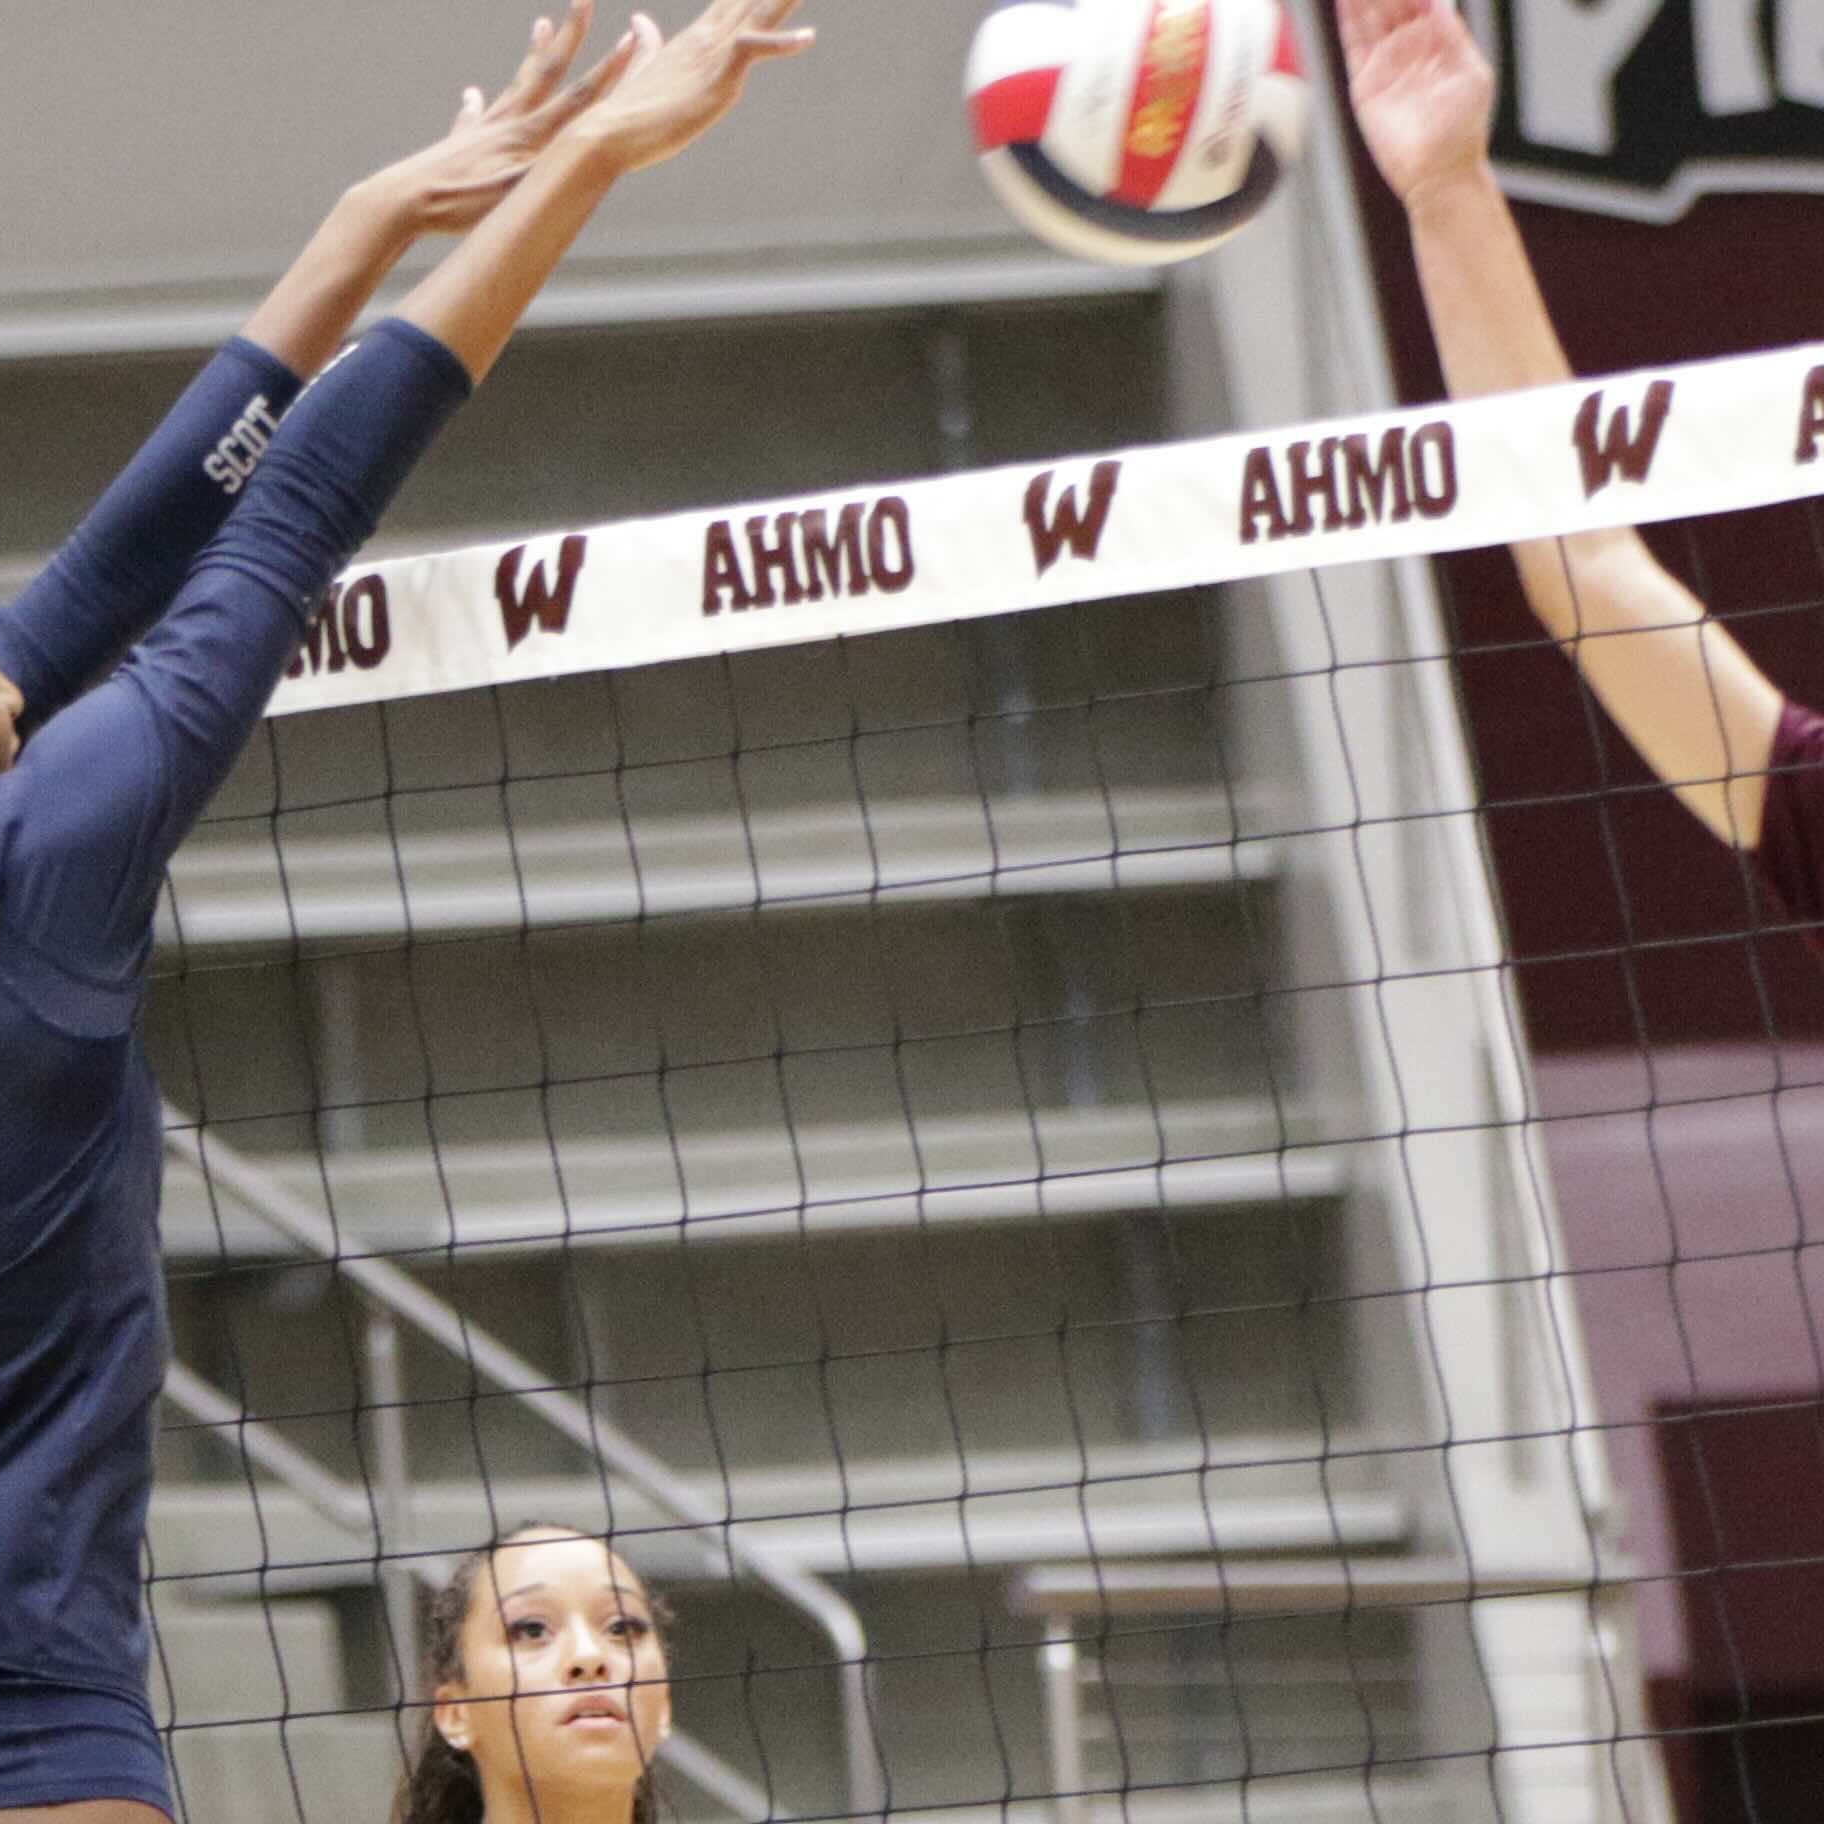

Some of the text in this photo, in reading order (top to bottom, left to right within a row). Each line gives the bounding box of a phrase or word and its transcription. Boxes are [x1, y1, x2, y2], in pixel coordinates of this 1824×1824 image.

[492, 533, 588, 651] W
[700, 495, 917, 618] AHMO
[1021, 459, 1120, 575] W
[1238, 420, 1460, 545] AHMO
[1571, 379, 1675, 497] W
